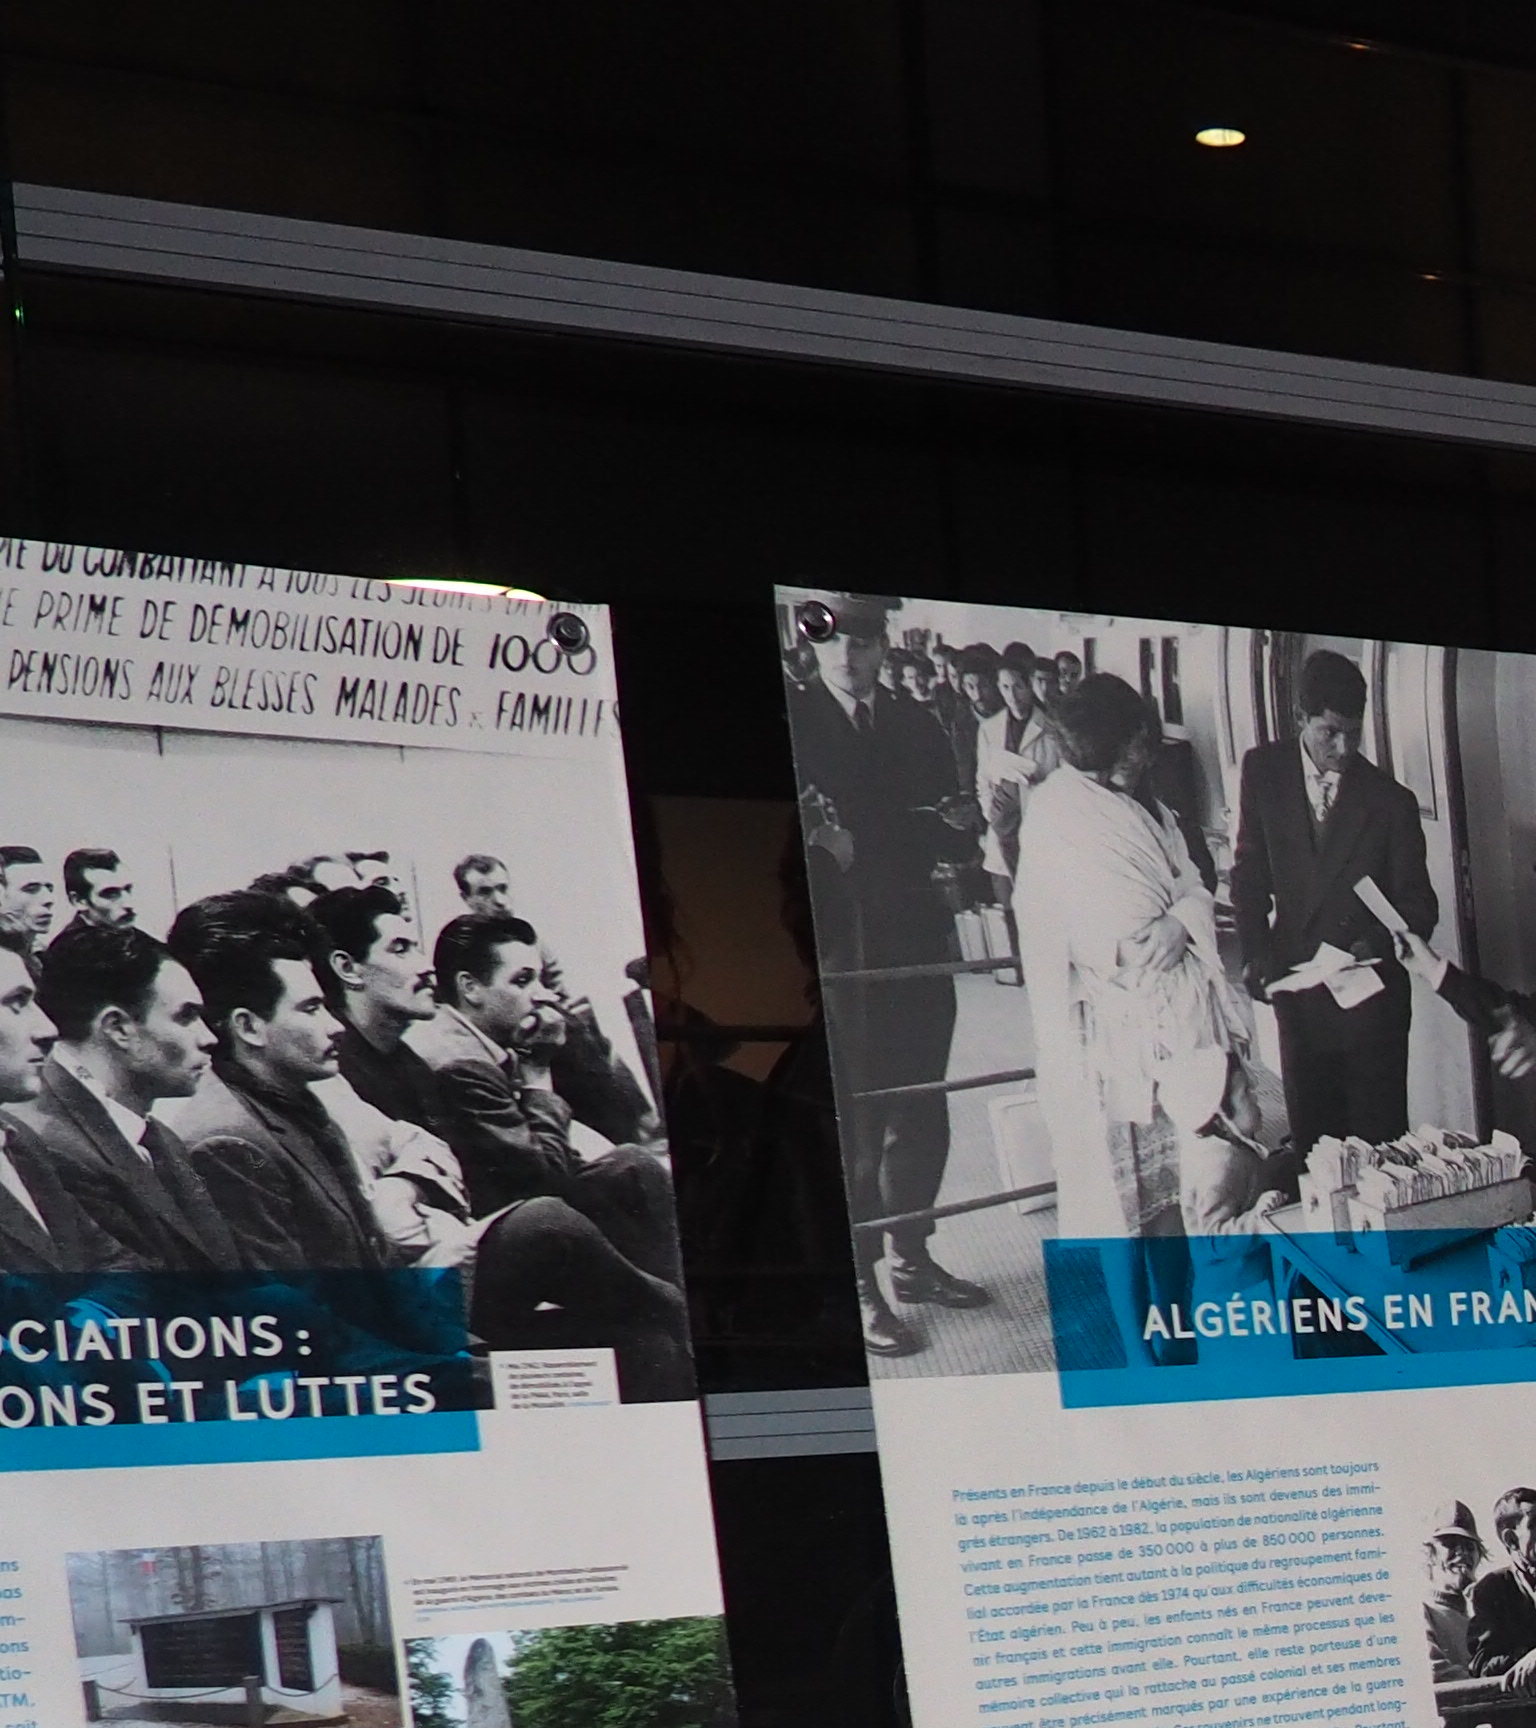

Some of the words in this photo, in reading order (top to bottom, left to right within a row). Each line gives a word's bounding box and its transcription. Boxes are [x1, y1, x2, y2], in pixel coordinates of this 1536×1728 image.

[34, 589, 124, 637] PRIME
[139, 599, 177, 641] DE
[189, 602, 424, 663] DEMOBILISATION
[432, 625, 465, 667] DE
[8, 648, 134, 701] PENSIONS
[147, 661, 199, 705] AUX
[210, 664, 318, 716] BLESSES
[335, 675, 461, 728] MALADES
[1143, 1293, 1368, 1341] ALGÉRIENS
[1384, 1293, 1434, 1330] EN
[138, 1381, 203, 1425] ET
[224, 1372, 437, 1423] LUTTES
[960, 1559, 1002, 1573] vivant
[1007, 1557, 1023, 1570] en
[1028, 1553, 1072, 1567] France
[1077, 1551, 1112, 1566] passe
[1118, 1547, 1133, 1560] de
[1214, 1537, 1238, 1552] plus
[1242, 1536, 1257, 1549] de
[1322, 1527, 1385, 1544] personnes.
